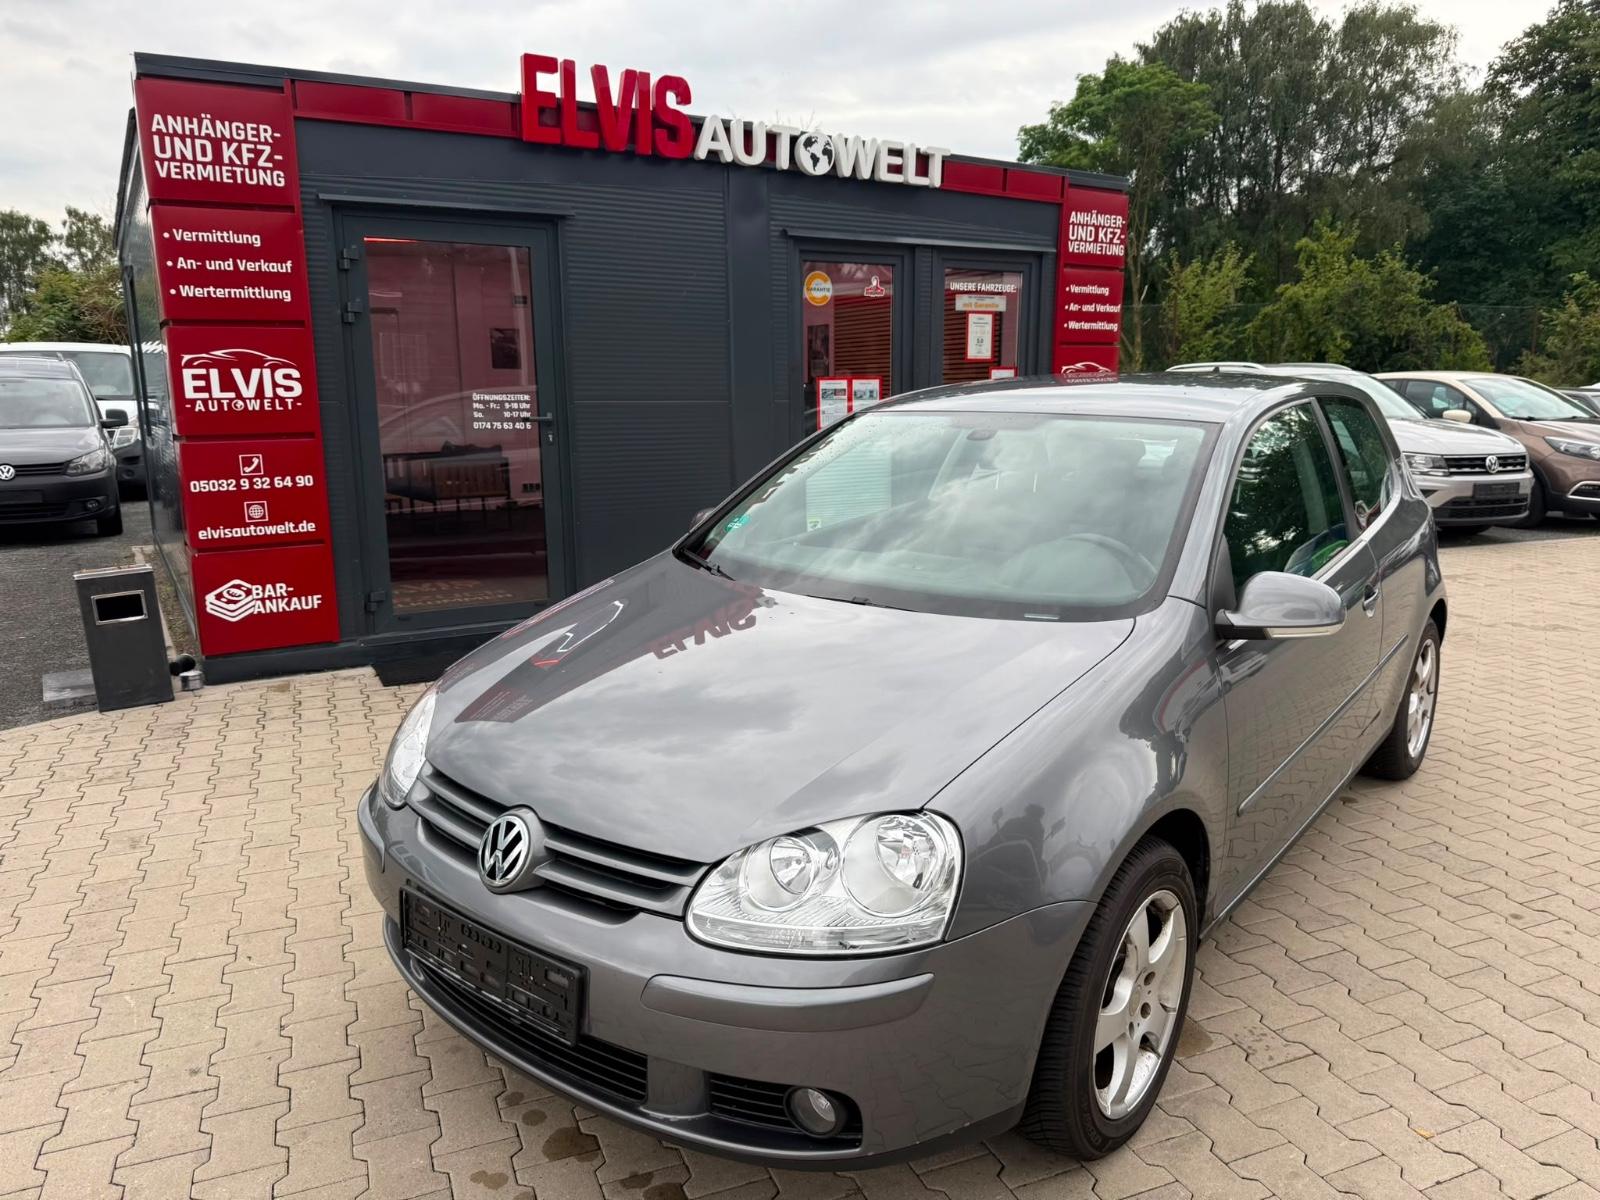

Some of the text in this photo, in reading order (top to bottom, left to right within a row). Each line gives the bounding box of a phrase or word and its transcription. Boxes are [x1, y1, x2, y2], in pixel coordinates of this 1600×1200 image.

[521, 52, 694, 159] ELVIS
[151, 114, 281, 143] ANHÄNGER-
[153, 135, 283, 168] UND KFZ-
[155, 161, 285, 187] VERMIETUNG
[1069, 210, 1126, 228] ANHÄNGER-
[173, 228, 261, 247] Vermittlung
[1069, 225, 1125, 243] UND KFZ-
[1068, 241, 1124, 256] VERMIETUNG
[177, 257, 292, 273] An- und Verkauf
[180, 285, 291, 301] Wertermittlung
[950, 281, 1017, 292] UNSERE FAHRZEUGE:
[1070, 284, 1109, 296] Vermittlung
[1069, 302, 1121, 312] An- und Verkauf
[1068, 321, 1118, 332] Wertermittlung
[182, 368, 303, 399] ELVIS
[190, 475, 314, 492] 05032 9 32 64 90
[198, 520, 316, 540] elvisautowelt.de
[252, 583, 294, 599] BAR-
[253, 594, 322, 615] ANKAUF
